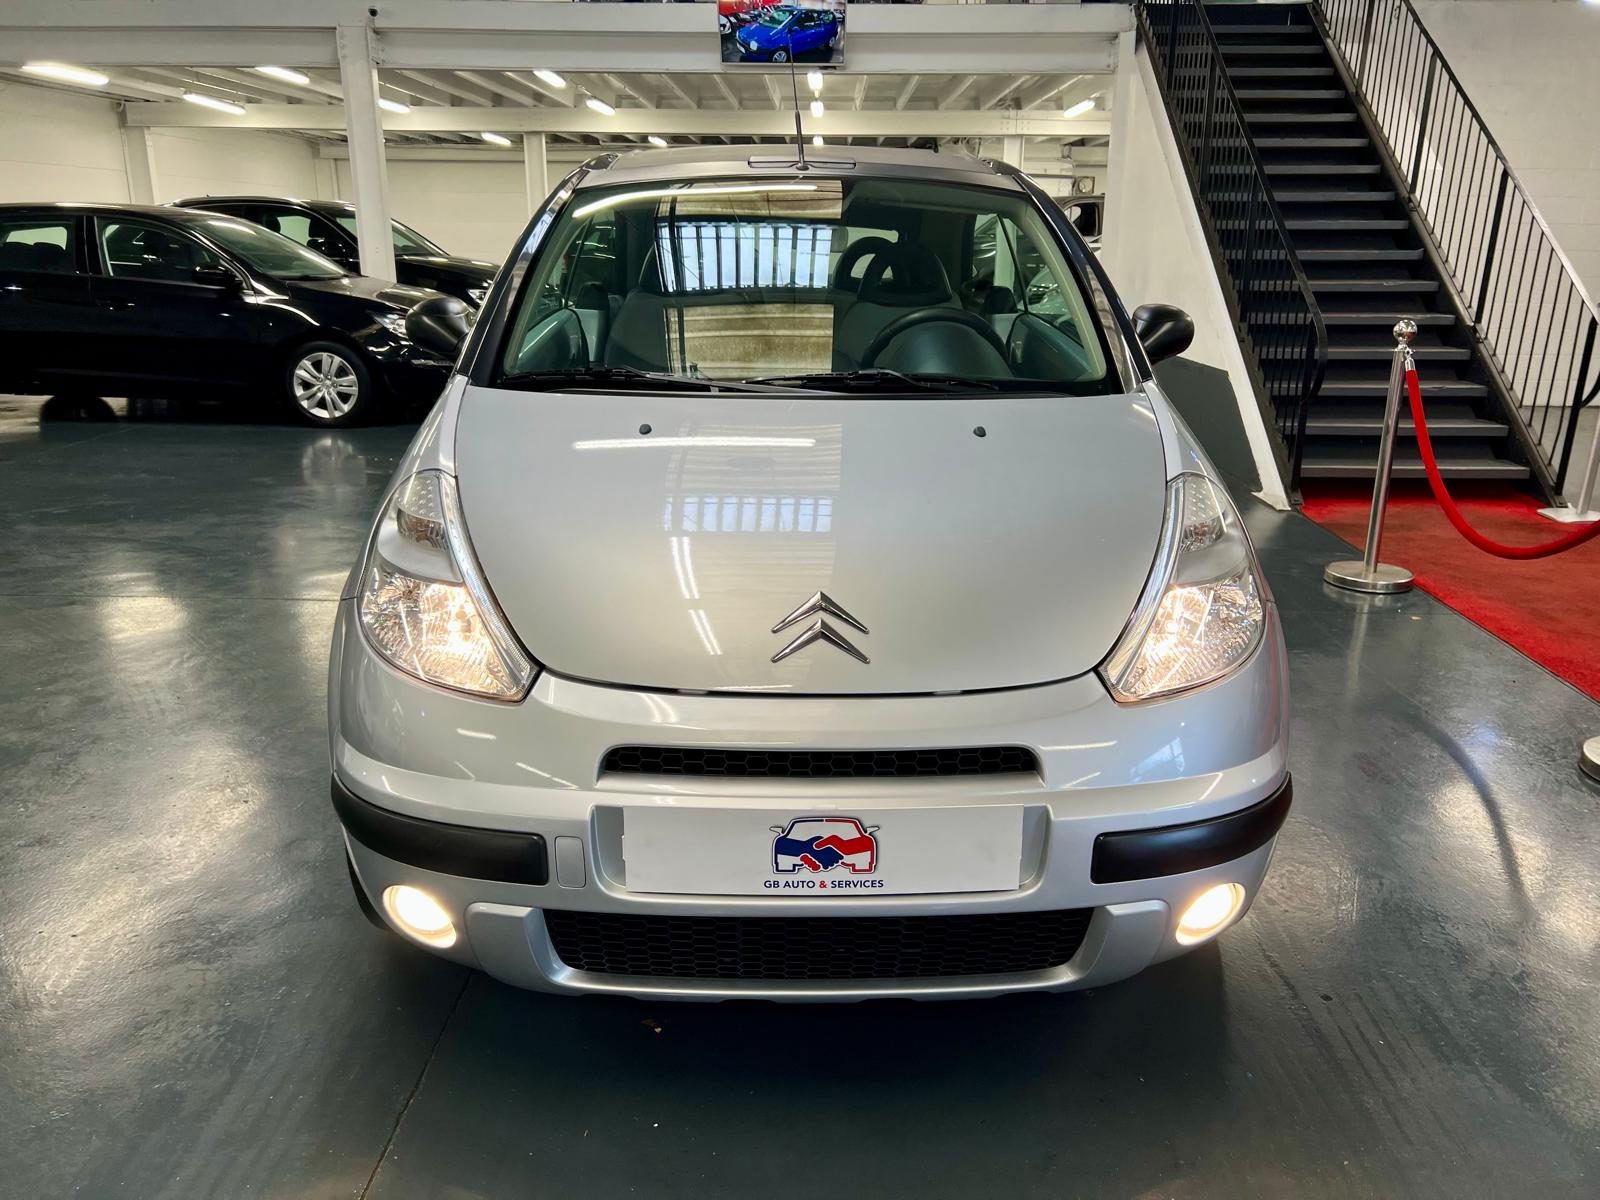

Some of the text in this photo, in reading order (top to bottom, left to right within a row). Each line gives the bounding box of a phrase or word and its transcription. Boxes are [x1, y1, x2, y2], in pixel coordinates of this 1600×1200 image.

[764, 879, 884, 889] GB AUTO & SERVICES
